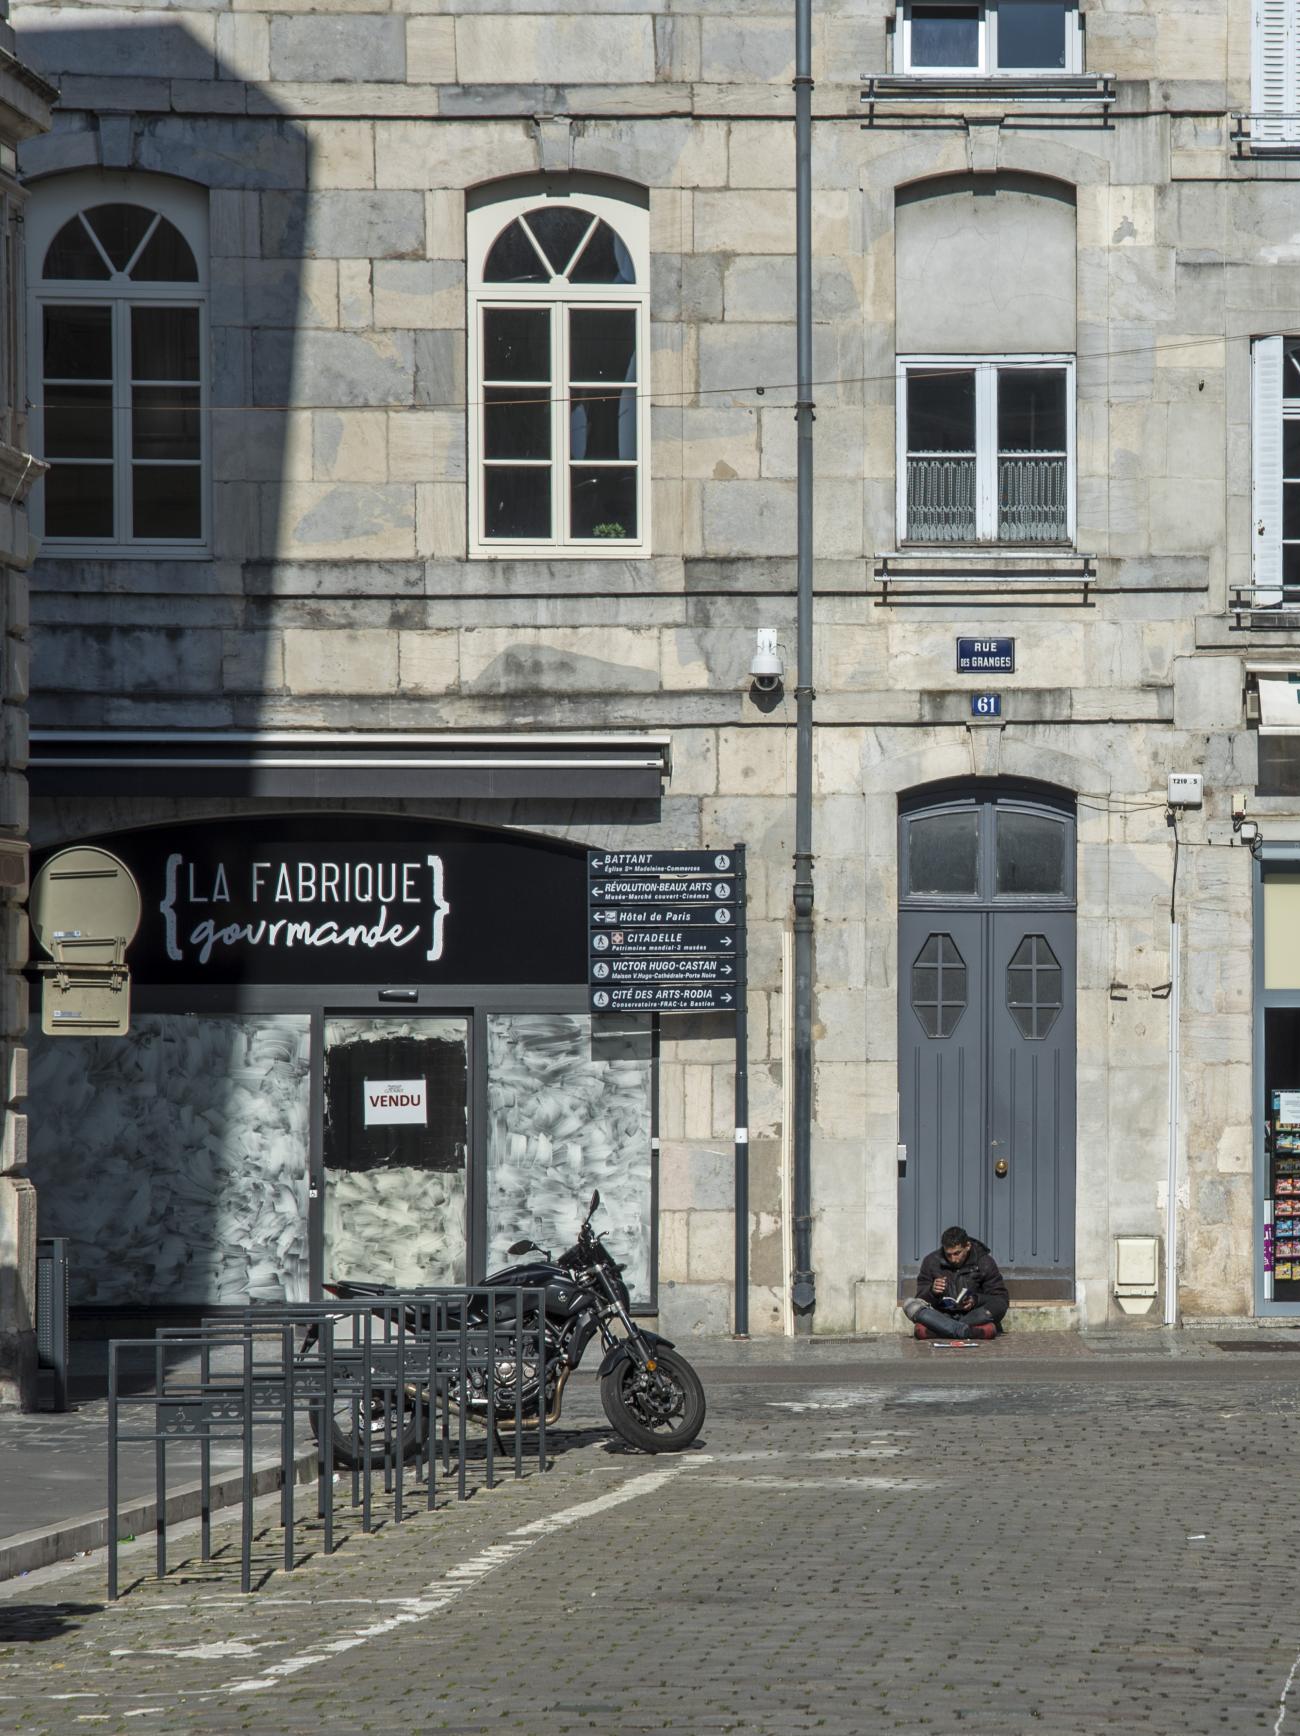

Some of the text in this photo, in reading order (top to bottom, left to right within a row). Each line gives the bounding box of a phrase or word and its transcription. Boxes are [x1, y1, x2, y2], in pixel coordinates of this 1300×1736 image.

[974, 642, 997, 652] RUE
[960, 657, 1011, 667] DES GRANGES
[977, 696, 995, 713] 61
[604, 854, 653, 864] BATTANT
[604, 865, 623, 873] Église
[189, 862, 422, 902] LA FABRIQUE
[604, 881, 713, 892] RÉVOLUTION-BEAUX ARTS
[619, 911, 691, 921] Hôtel de Paris
[190, 904, 421, 964] gourmande
[627, 933, 683, 943] CITADELLE
[612, 961, 718, 971] VICTOR HUGO-CASTAN
[612, 988, 713, 999] CITÉ DES ARTS-RODIA
[369, 1094, 421, 1107] VENDU
